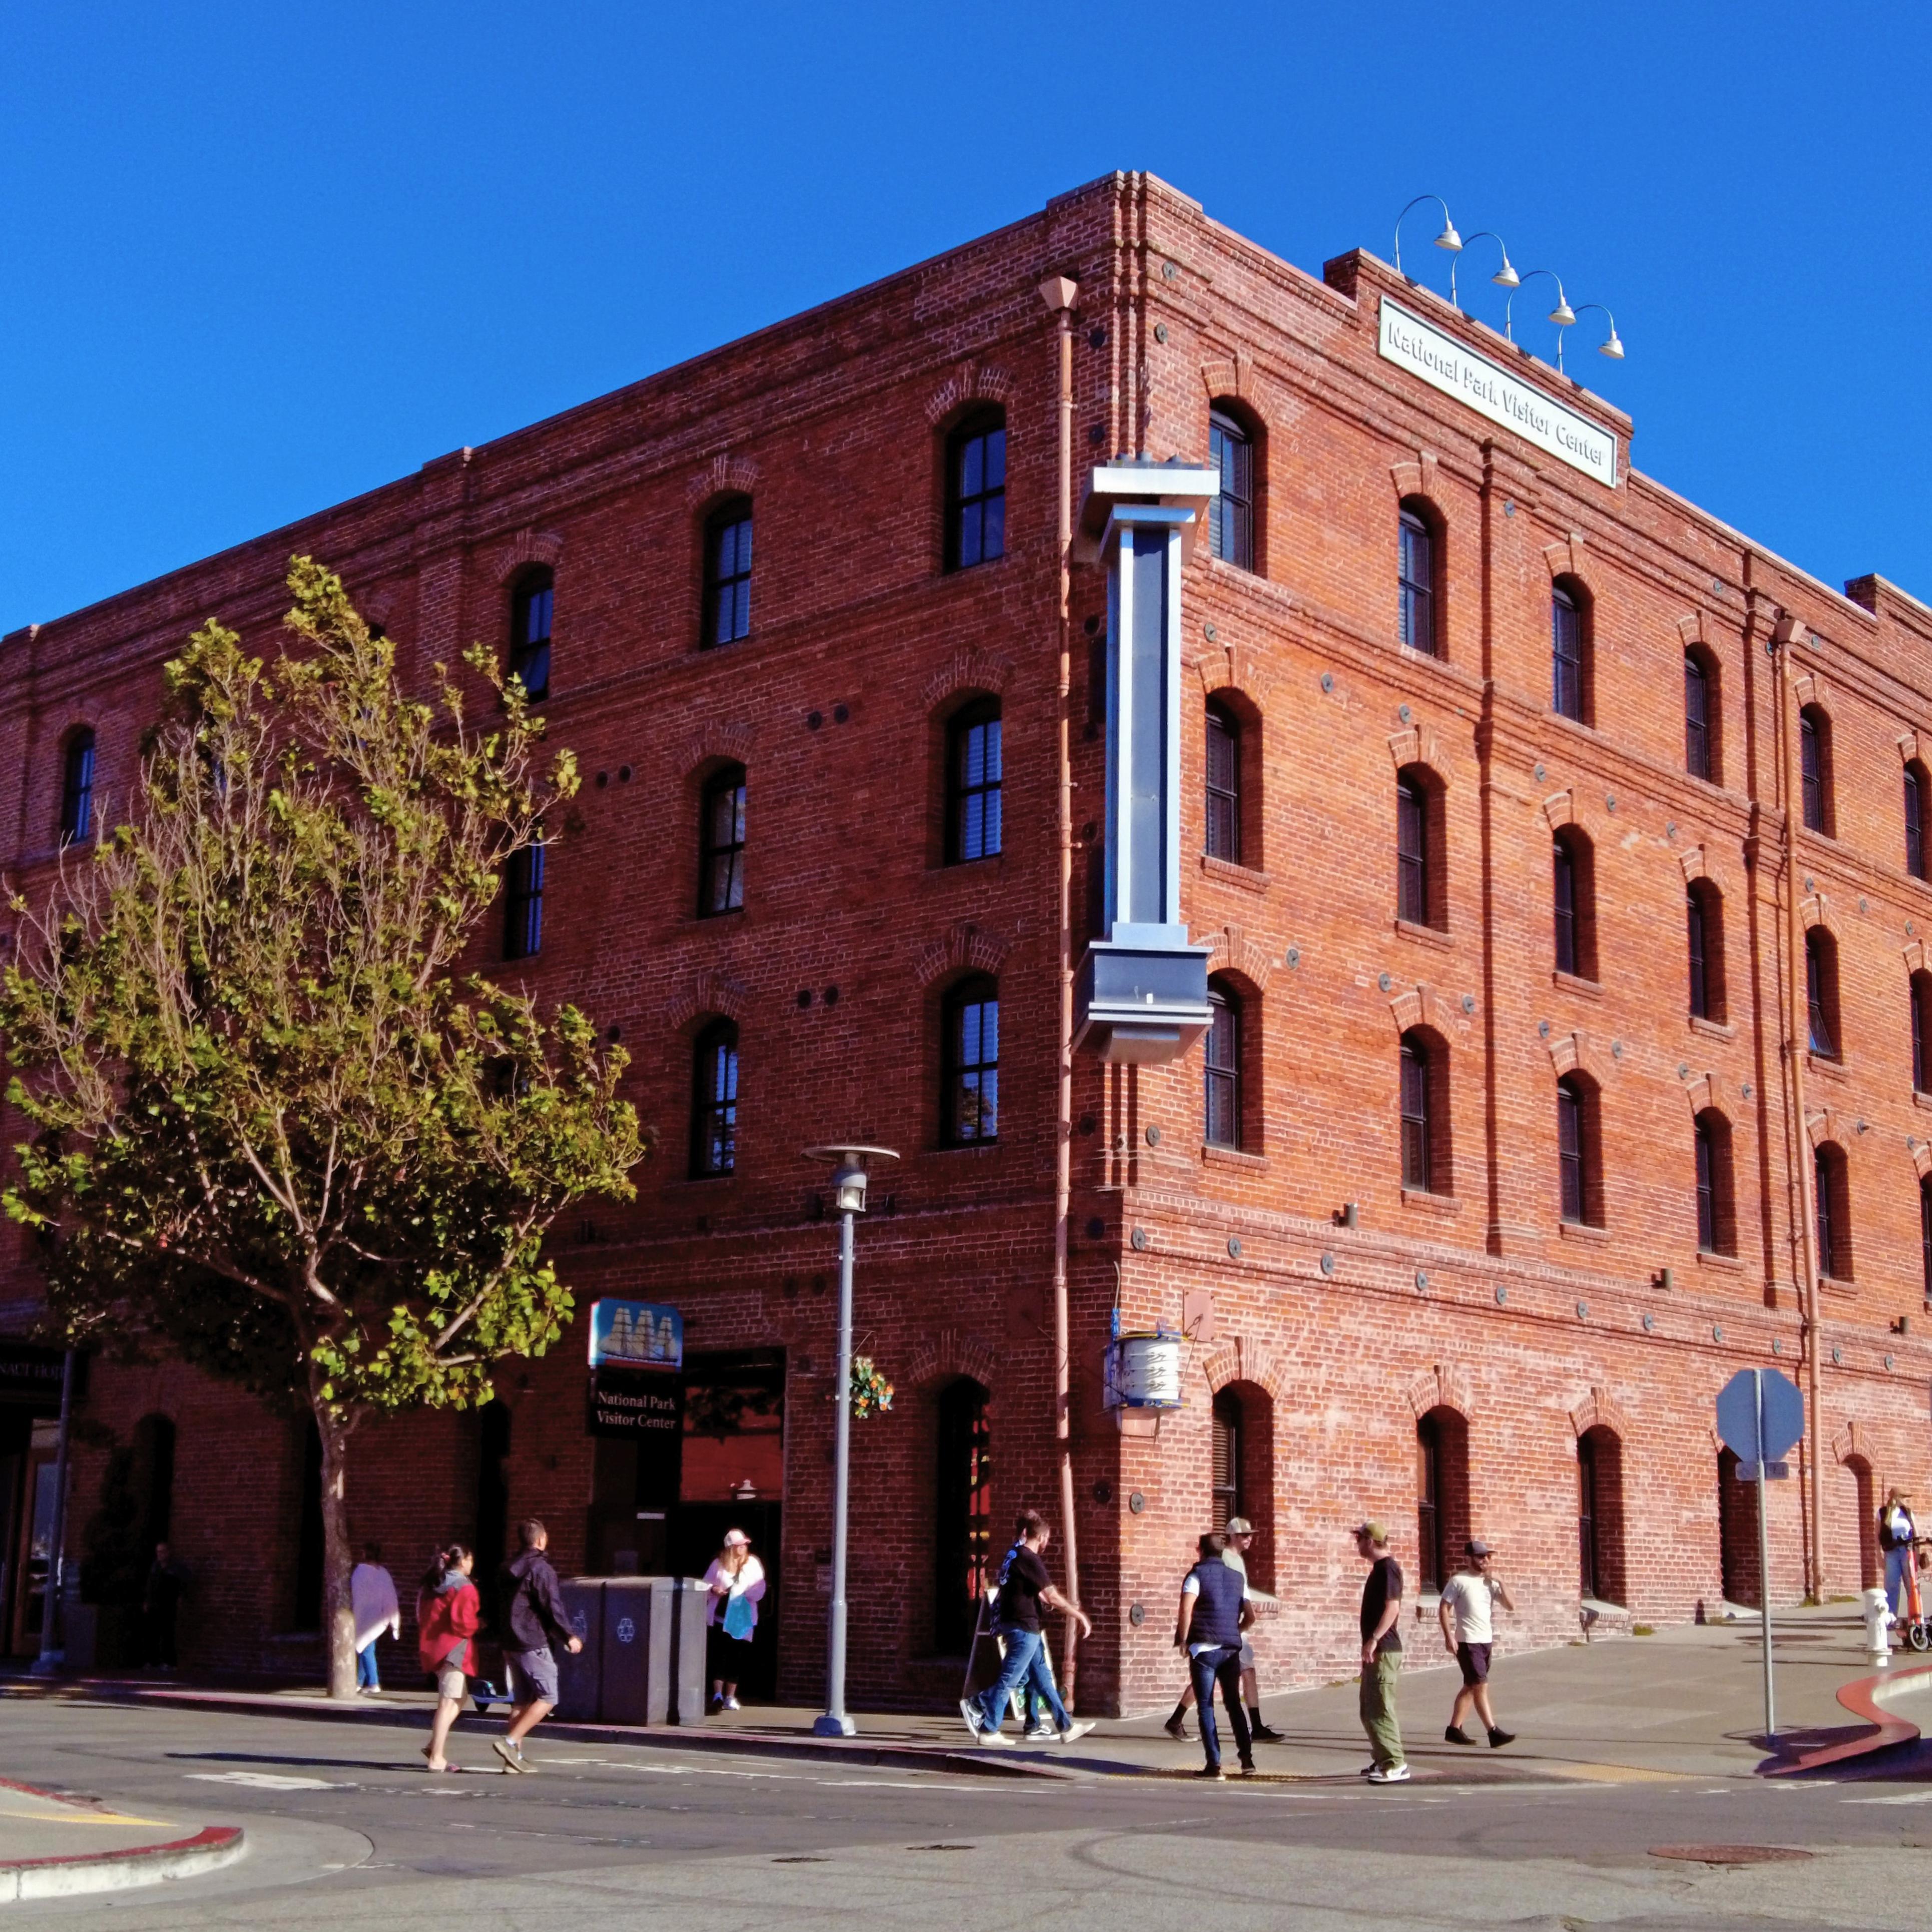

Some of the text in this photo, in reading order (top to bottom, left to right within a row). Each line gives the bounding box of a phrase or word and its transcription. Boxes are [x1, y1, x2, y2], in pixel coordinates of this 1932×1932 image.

[1388, 321, 1604, 466] National Park Visitor Center
[598, 1391, 676, 1410] National Park
[597, 1410, 676, 1429] Visitor Center
